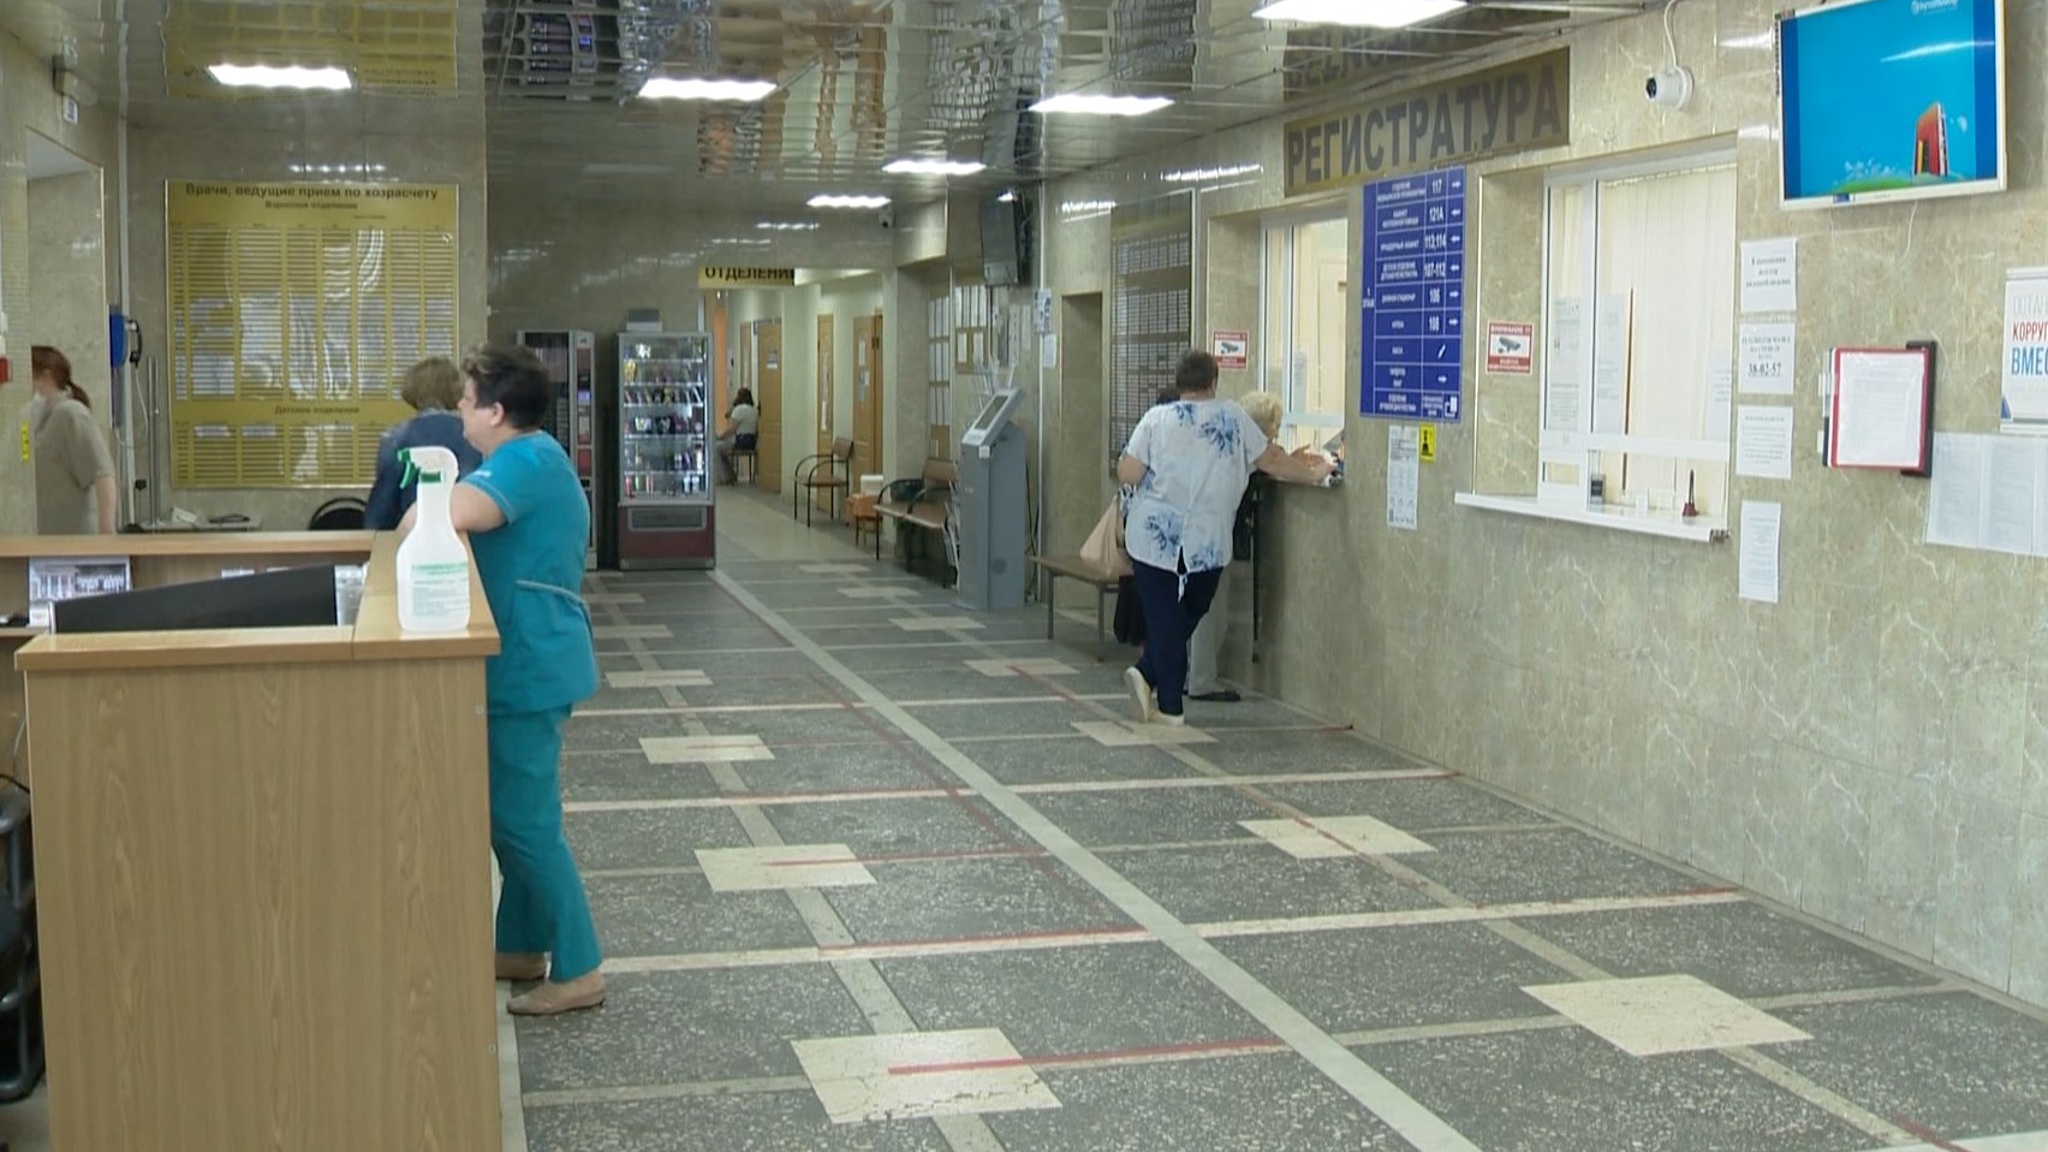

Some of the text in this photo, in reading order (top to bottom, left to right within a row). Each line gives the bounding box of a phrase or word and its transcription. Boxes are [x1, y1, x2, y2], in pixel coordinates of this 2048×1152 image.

[1287, 63, 1562, 188] РЕГИСТРАТУРА
[185, 183, 438, 200] Врачи, ведущие прием по хозрасчету
[1432, 179, 1442, 194] 117
[705, 267, 795, 282] ОТДЕЛЕНИ
[1748, 362, 1782, 374] 38-02-57
